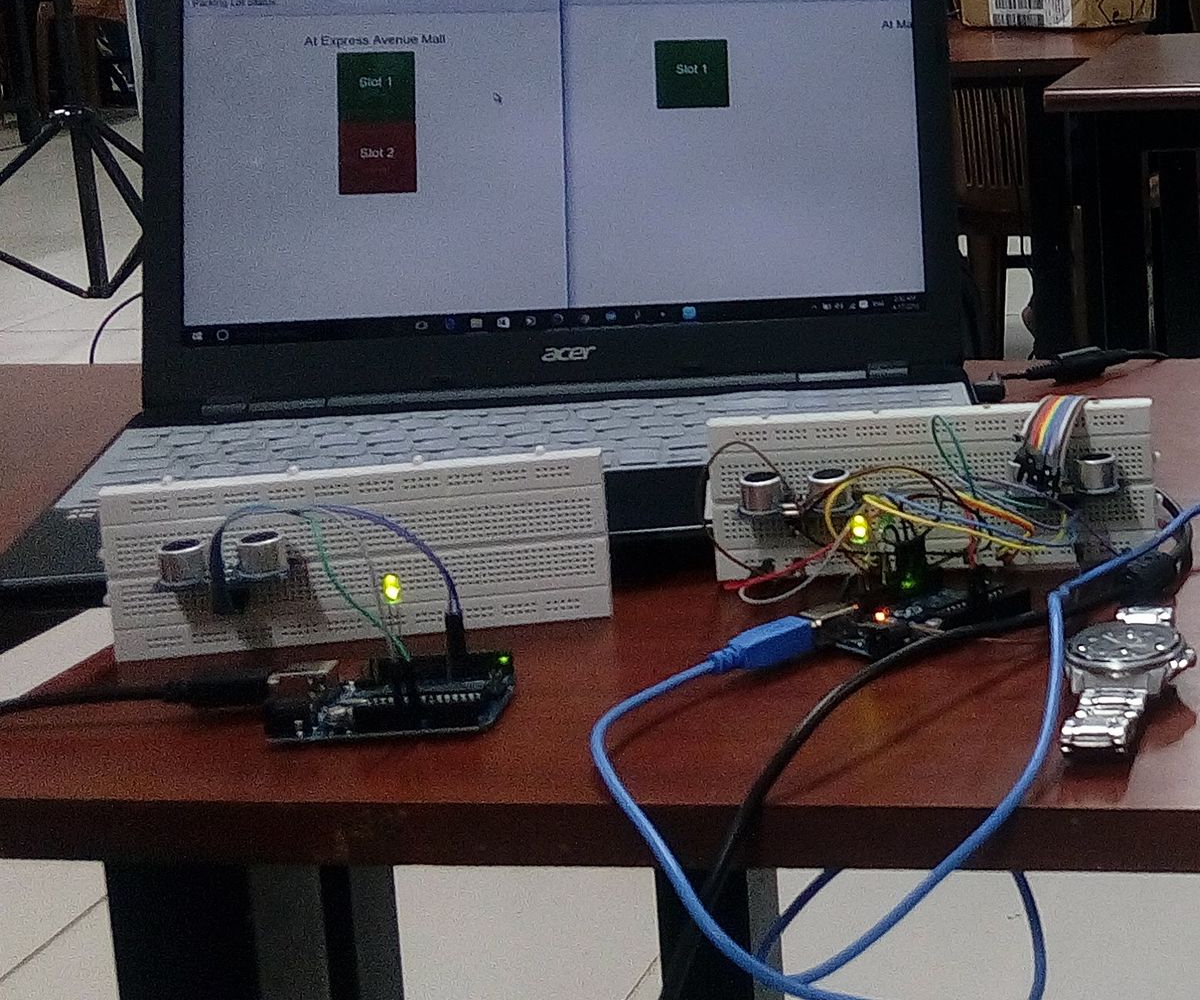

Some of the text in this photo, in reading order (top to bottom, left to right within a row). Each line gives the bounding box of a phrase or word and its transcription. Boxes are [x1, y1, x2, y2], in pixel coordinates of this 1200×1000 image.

[303, 33, 446, 48] At Express Avenue Mall
[675, 63, 699, 75] Slot
[359, 76, 383, 88] Slot
[360, 147, 384, 159] Slot
[541, 343, 597, 363] acer
